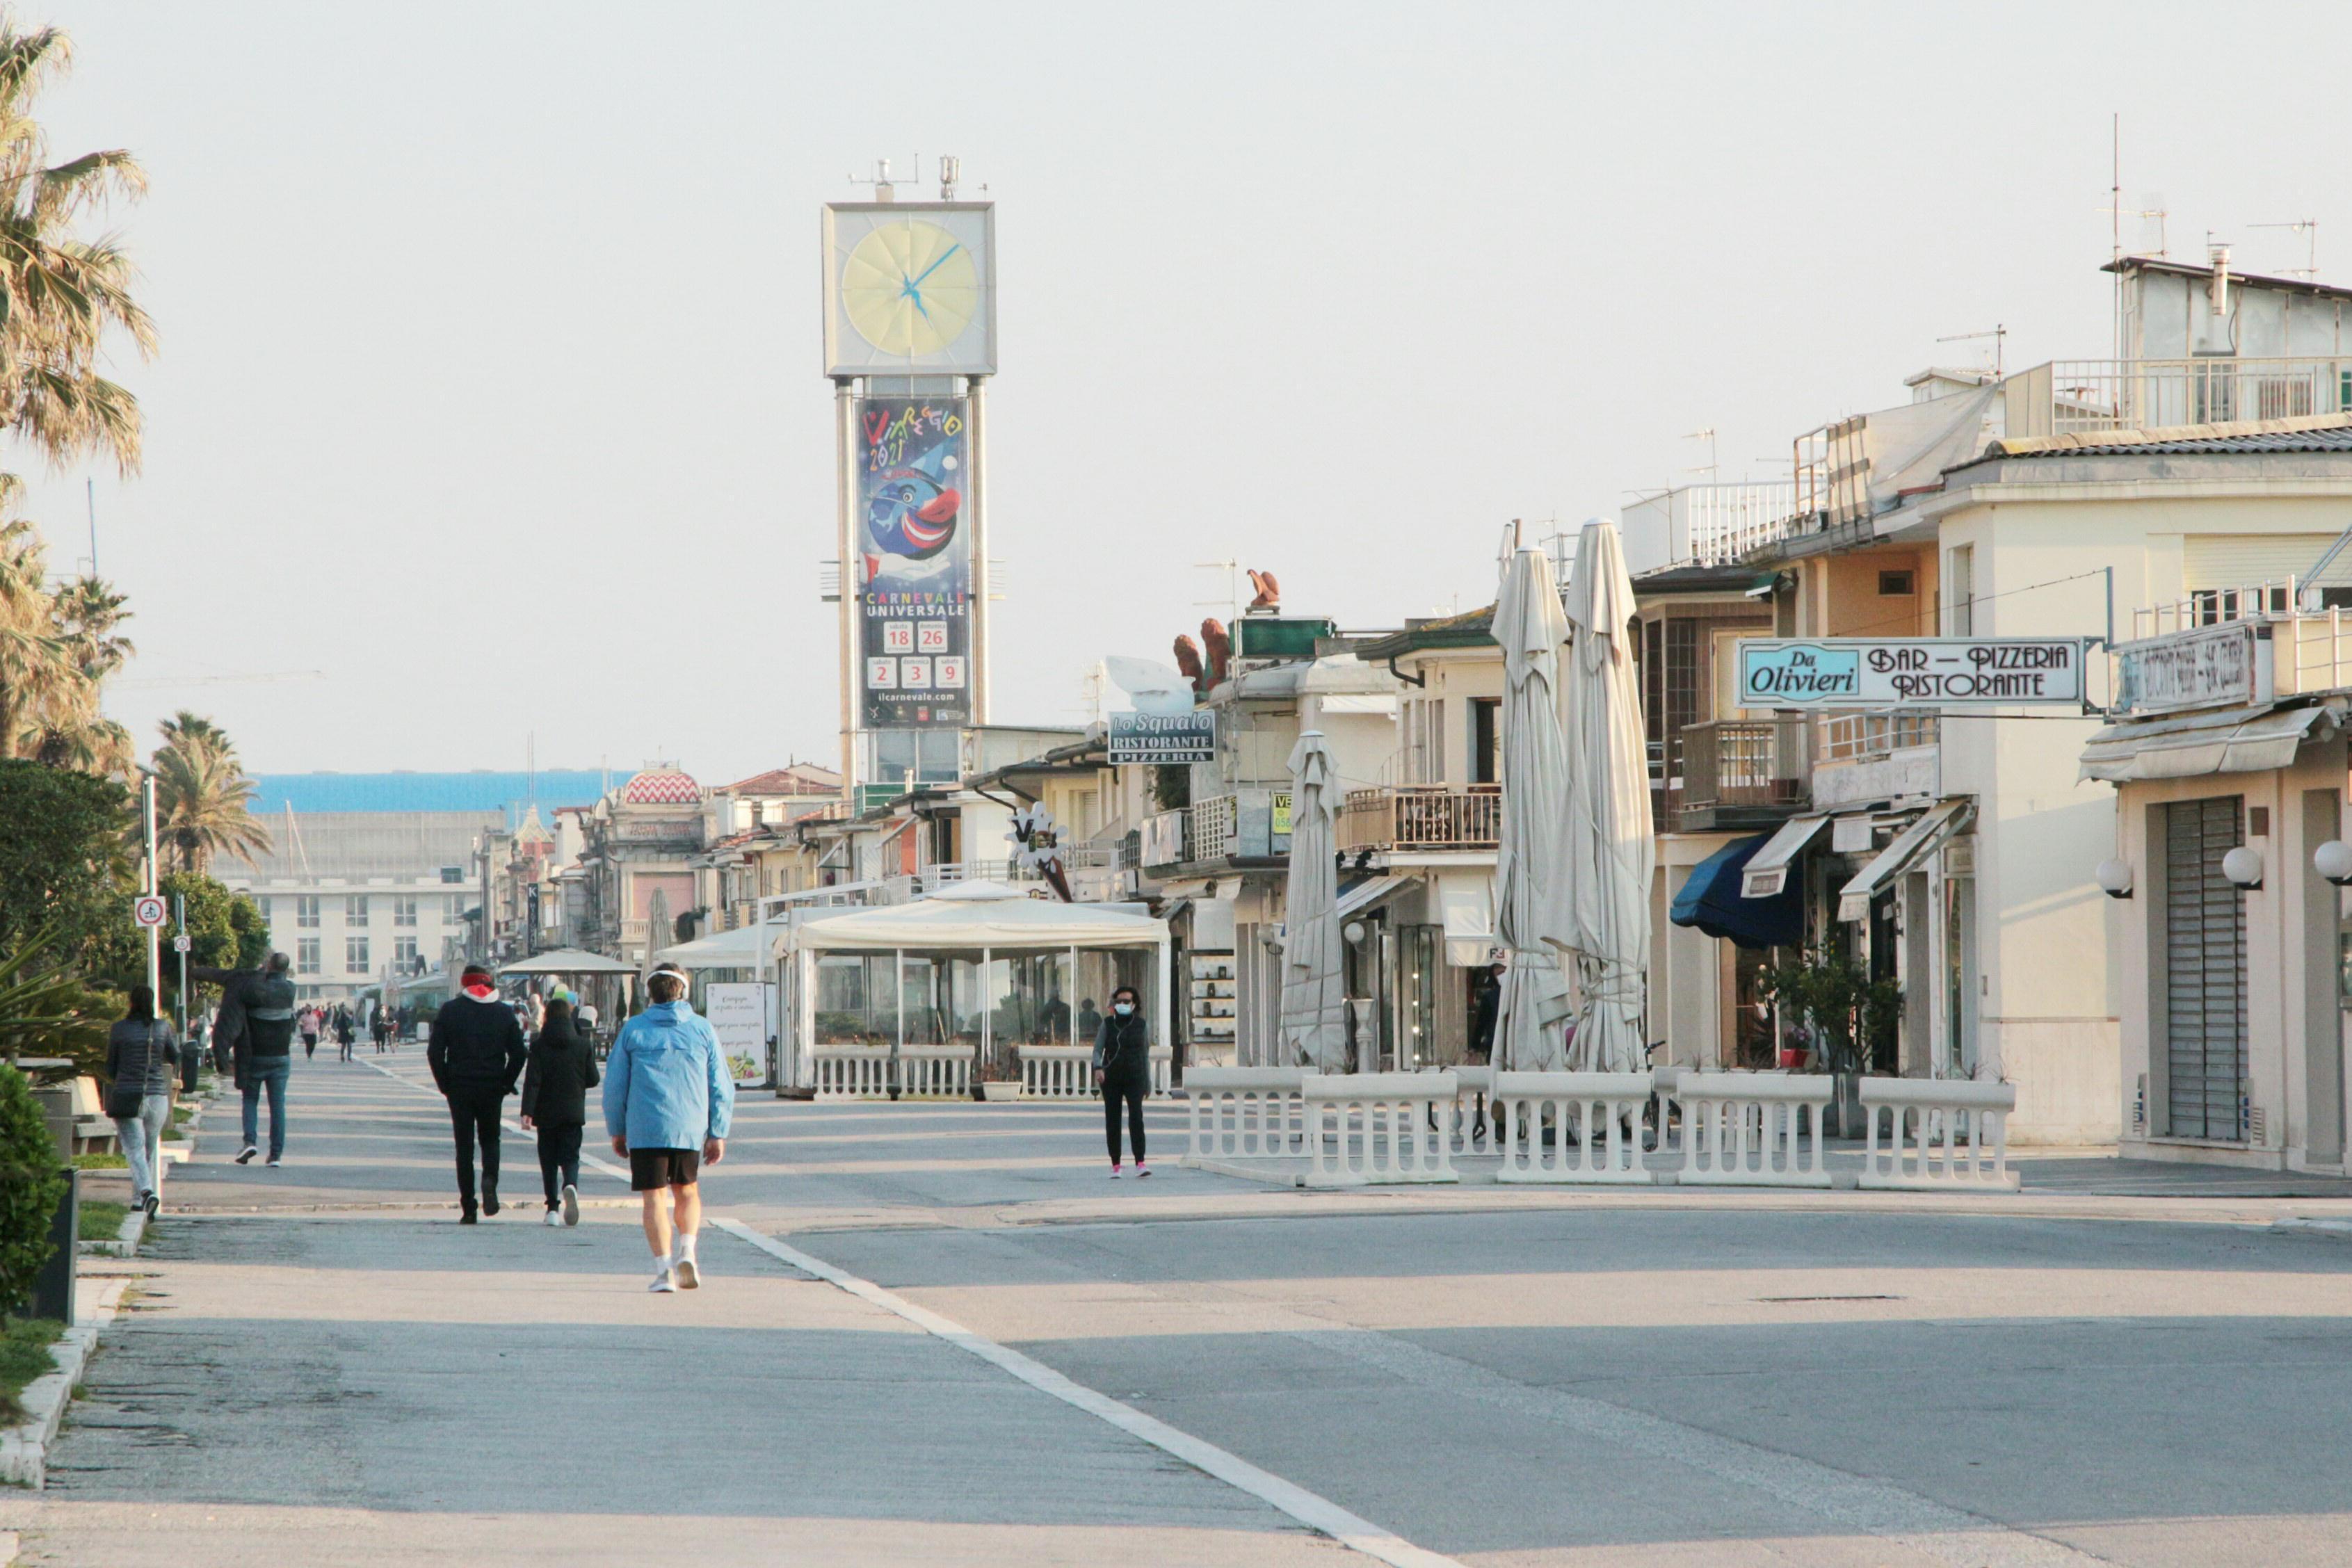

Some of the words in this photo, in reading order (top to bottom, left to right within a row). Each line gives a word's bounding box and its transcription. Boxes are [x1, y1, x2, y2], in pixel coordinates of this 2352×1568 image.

[870, 439, 903, 471] 2021
[867, 592, 965, 604] CARNEVALE
[867, 605, 965, 617] UNIVERSALE
[889, 631, 908, 645] 18
[923, 631, 943, 645] 26
[1789, 651, 1816, 667] Da
[878, 666, 887, 681] 2
[912, 666, 921, 680] 3
[945, 665, 955, 679] 9
[1750, 666, 1855, 692] Olivieri
[878, 693, 955, 701] ilcarnevale.com
[1113, 717, 1133, 731] Lo
[1136, 713, 1212, 735] Squalo
[1113, 736, 1209, 749] RISTORANTE
[1117, 752, 1207, 762] PIZZERIA
